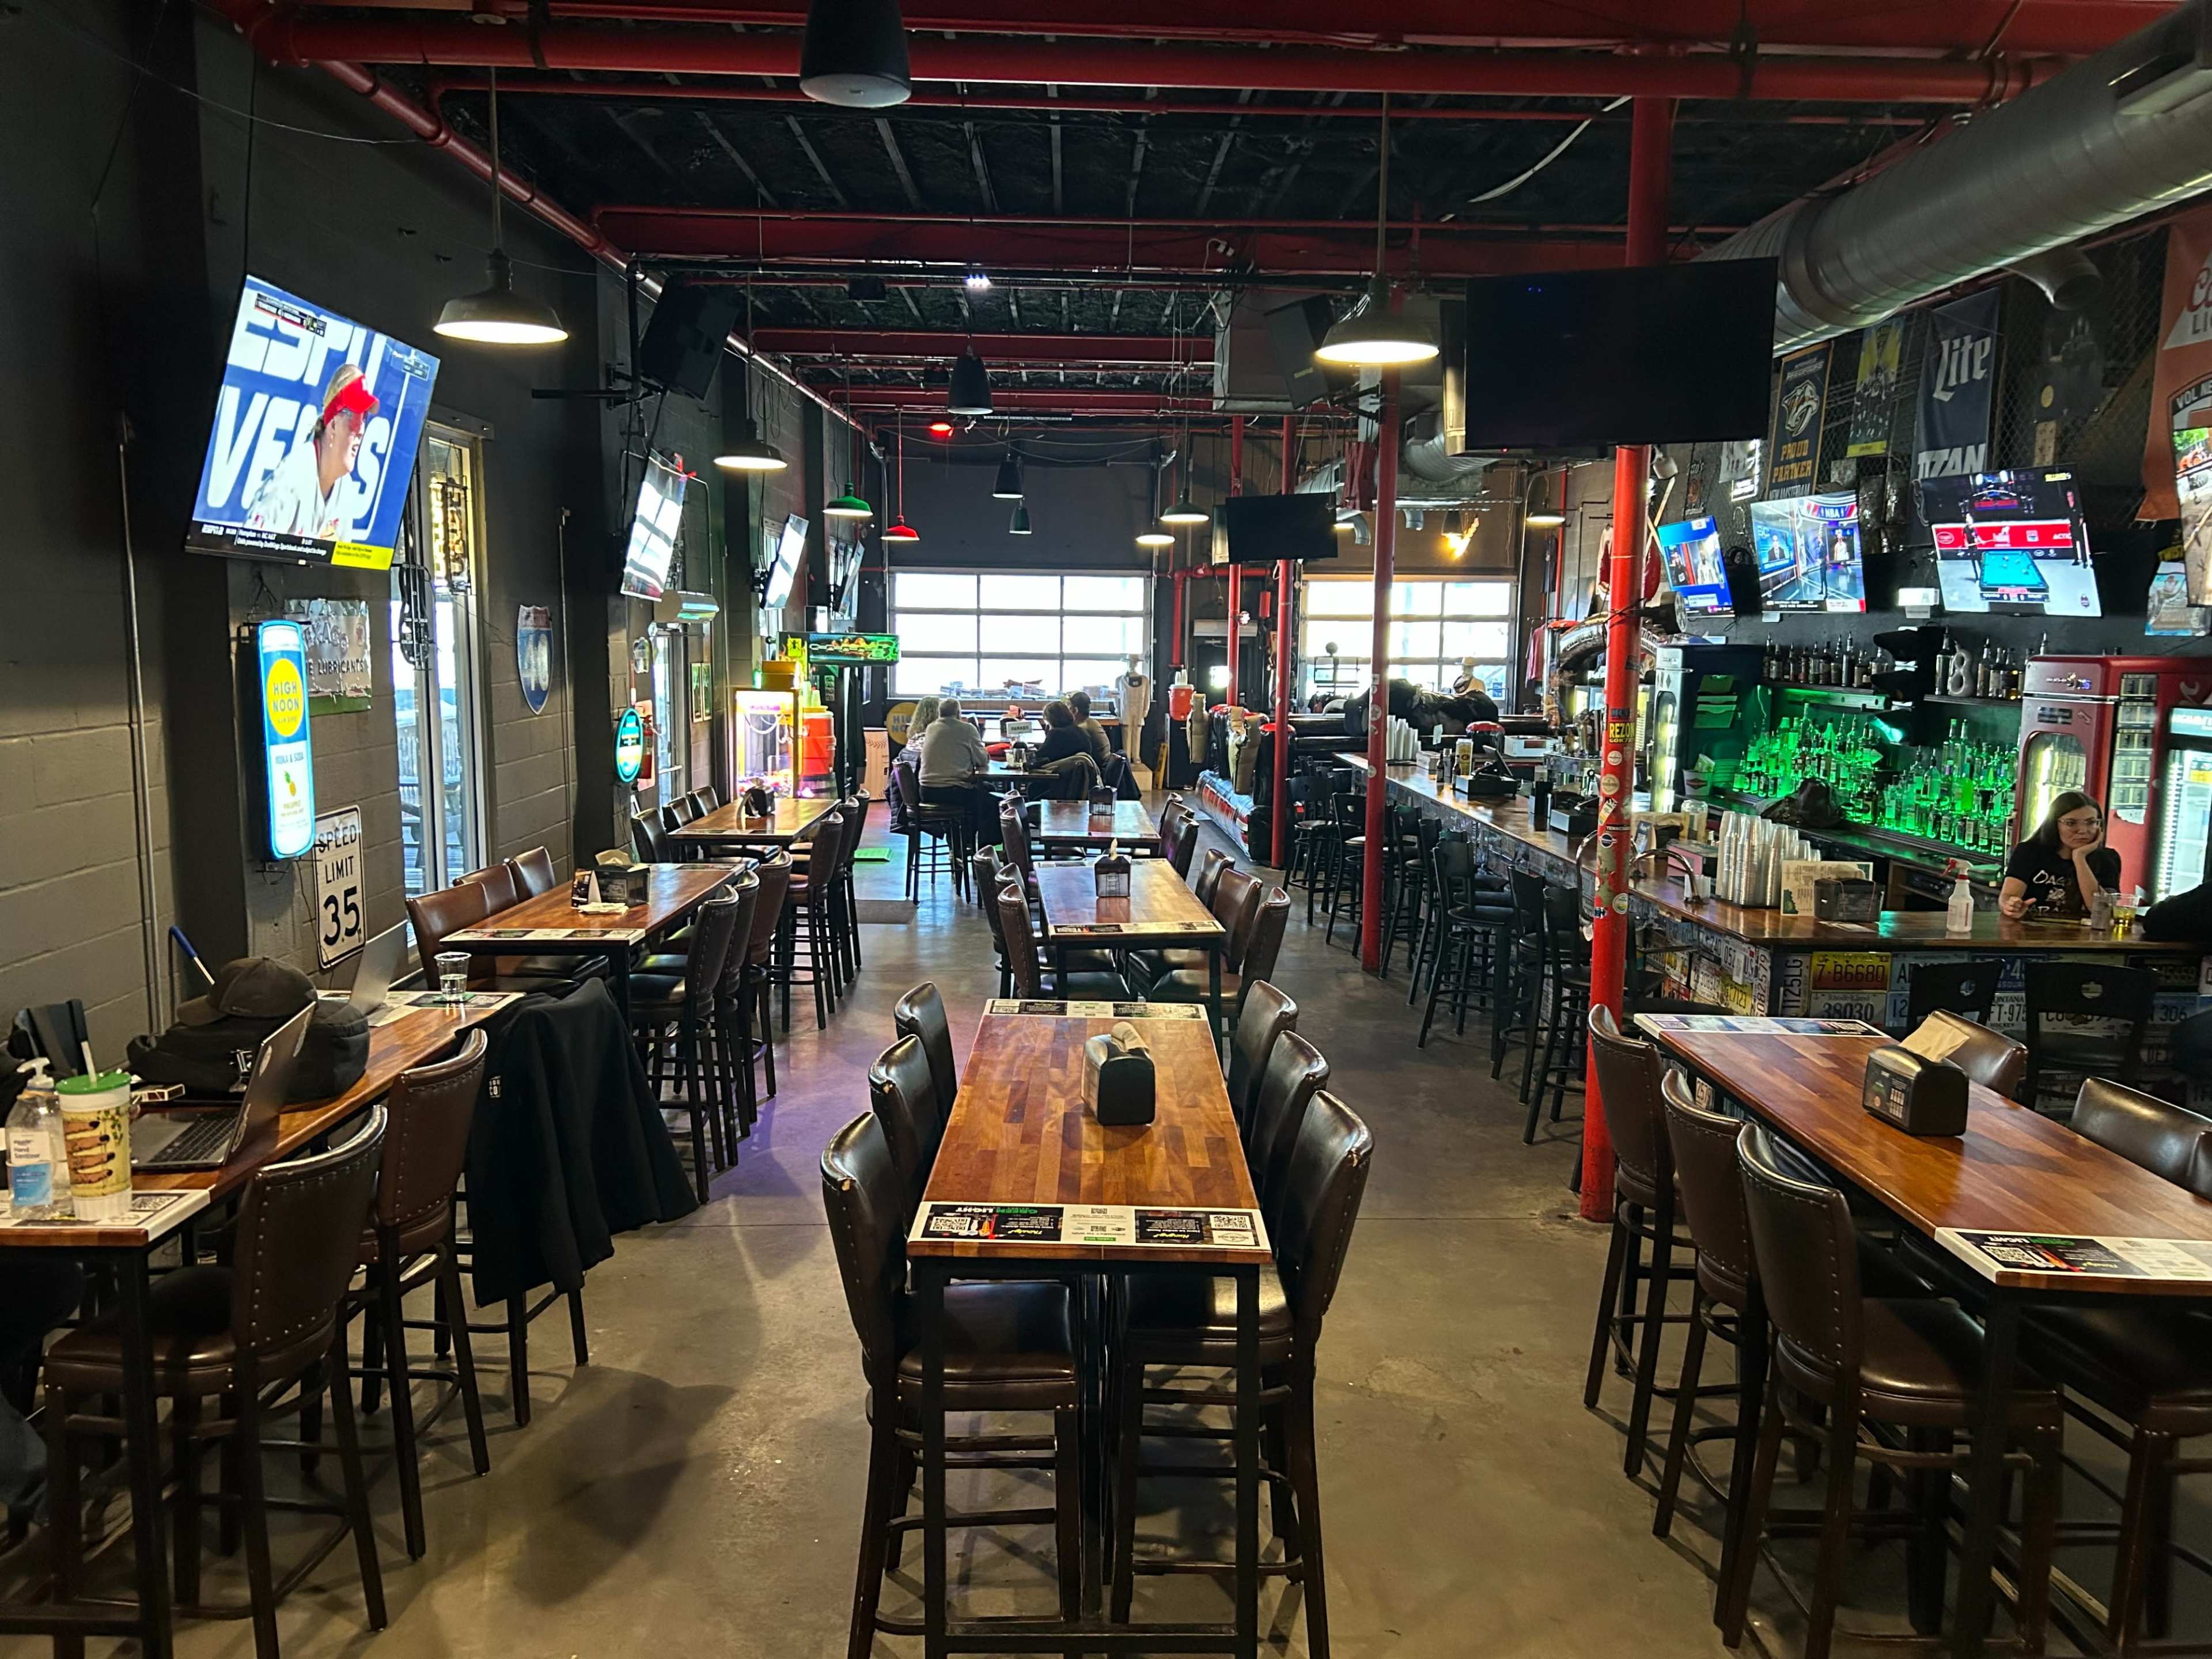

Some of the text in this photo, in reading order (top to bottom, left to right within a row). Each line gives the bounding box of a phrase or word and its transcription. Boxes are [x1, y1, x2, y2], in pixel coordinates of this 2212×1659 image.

[1933, 335, 1991, 402] Lite
[1781, 438, 1809, 461] PROUD
[1772, 460, 1813, 483] PARTNER
[1825, 507, 1840, 518] NBA
[318, 658, 363, 675] LUBRICANTS
[273, 681, 297, 695] HIGH
[273, 697, 299, 713] NOON
[319, 824, 357, 853] SPEED
[325, 856, 354, 884] LIMIT
[323, 886, 359, 946] 35
